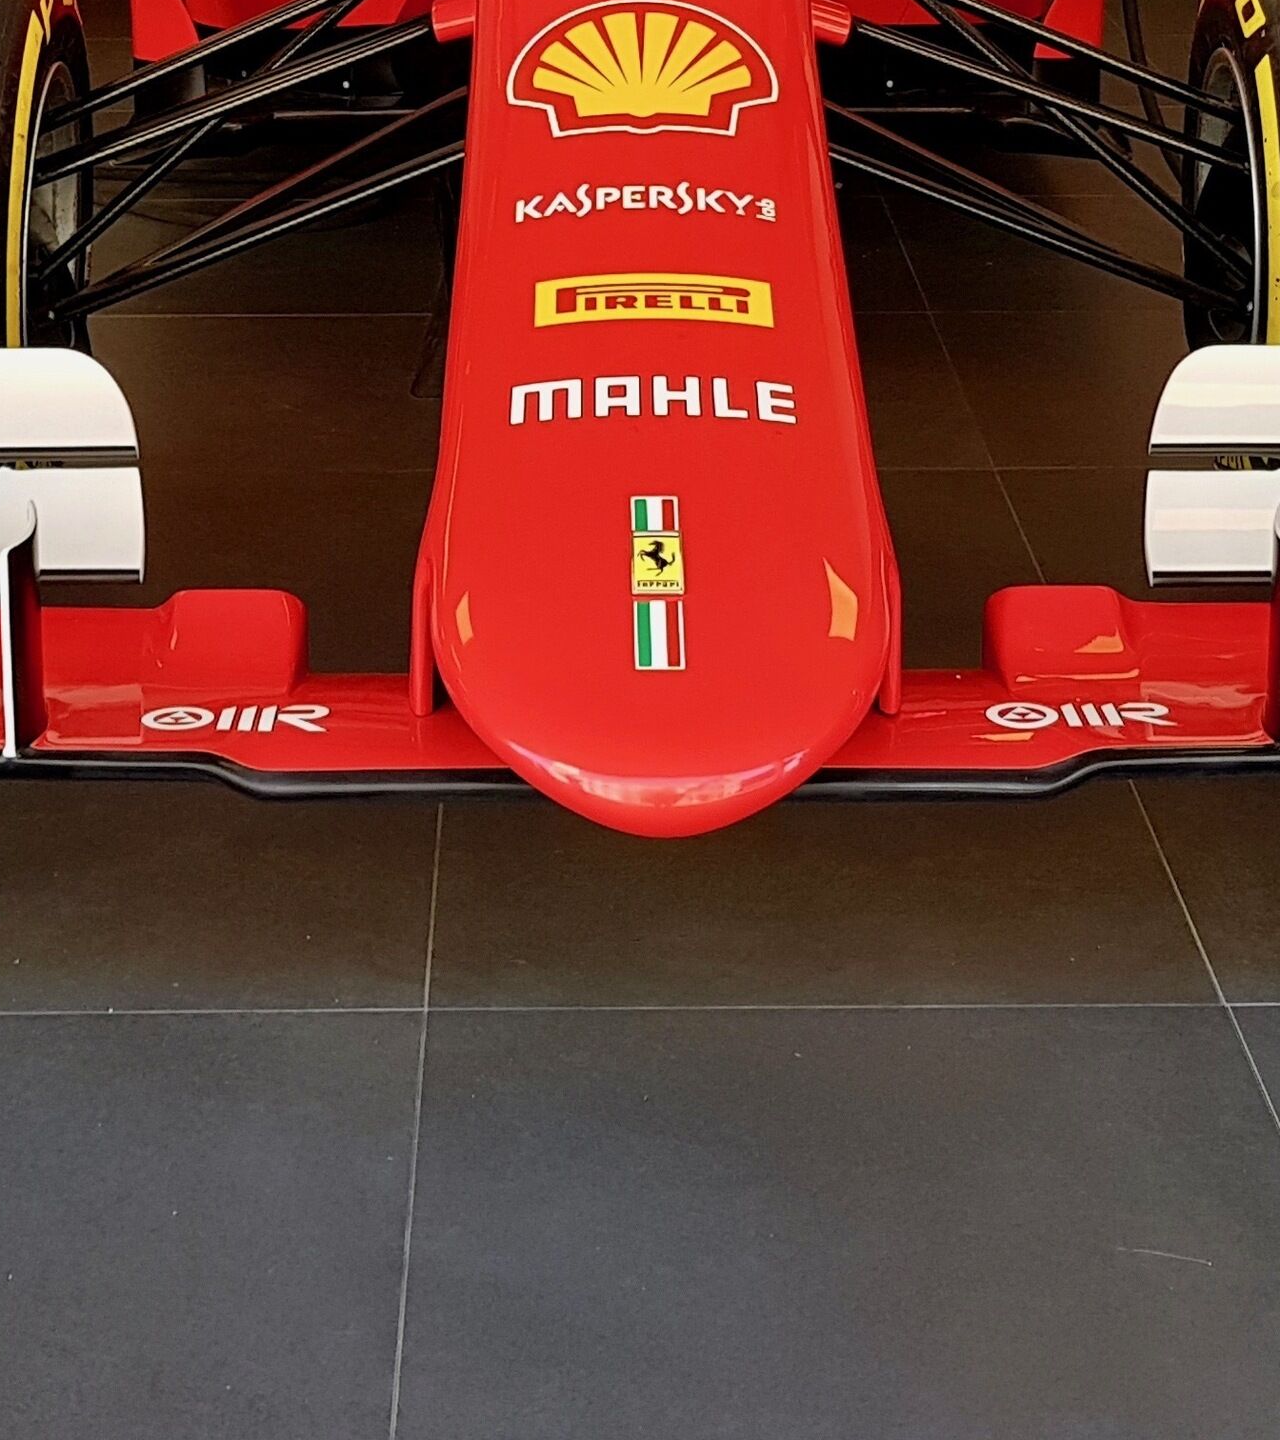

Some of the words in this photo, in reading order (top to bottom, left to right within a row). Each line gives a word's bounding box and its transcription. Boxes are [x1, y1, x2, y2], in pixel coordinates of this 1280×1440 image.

[514, 181, 754, 223] KASPERSKY
[555, 282, 752, 315] PIRELLI
[508, 374, 798, 426] MAHLE
